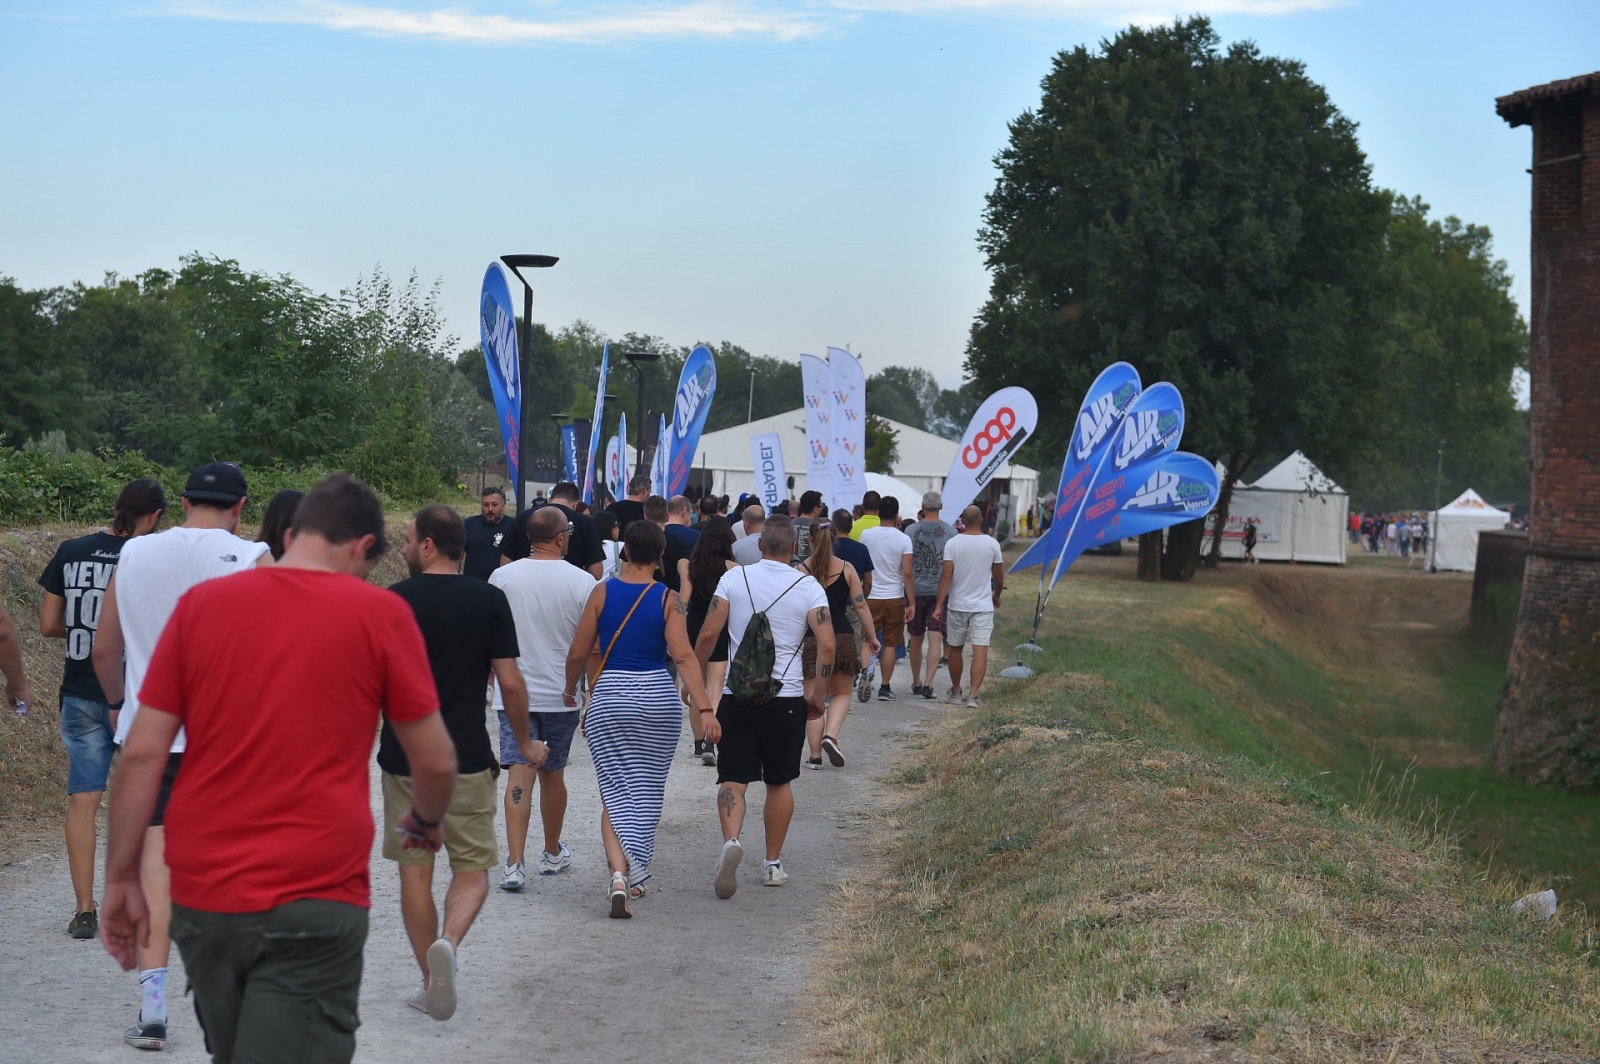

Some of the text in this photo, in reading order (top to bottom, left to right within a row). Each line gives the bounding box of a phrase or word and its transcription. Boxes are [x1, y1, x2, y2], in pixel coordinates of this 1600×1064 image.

[677, 373, 703, 439] AIR
[1077, 392, 1120, 460] AIR
[962, 407, 1016, 470] coop
[1115, 410, 1162, 470] AIR
[977, 450, 1008, 484] Lombardia
[1175, 481, 1209, 498] Action
[1179, 498, 1210, 512] Vigorsol
[63, 561, 117, 589] NEV
